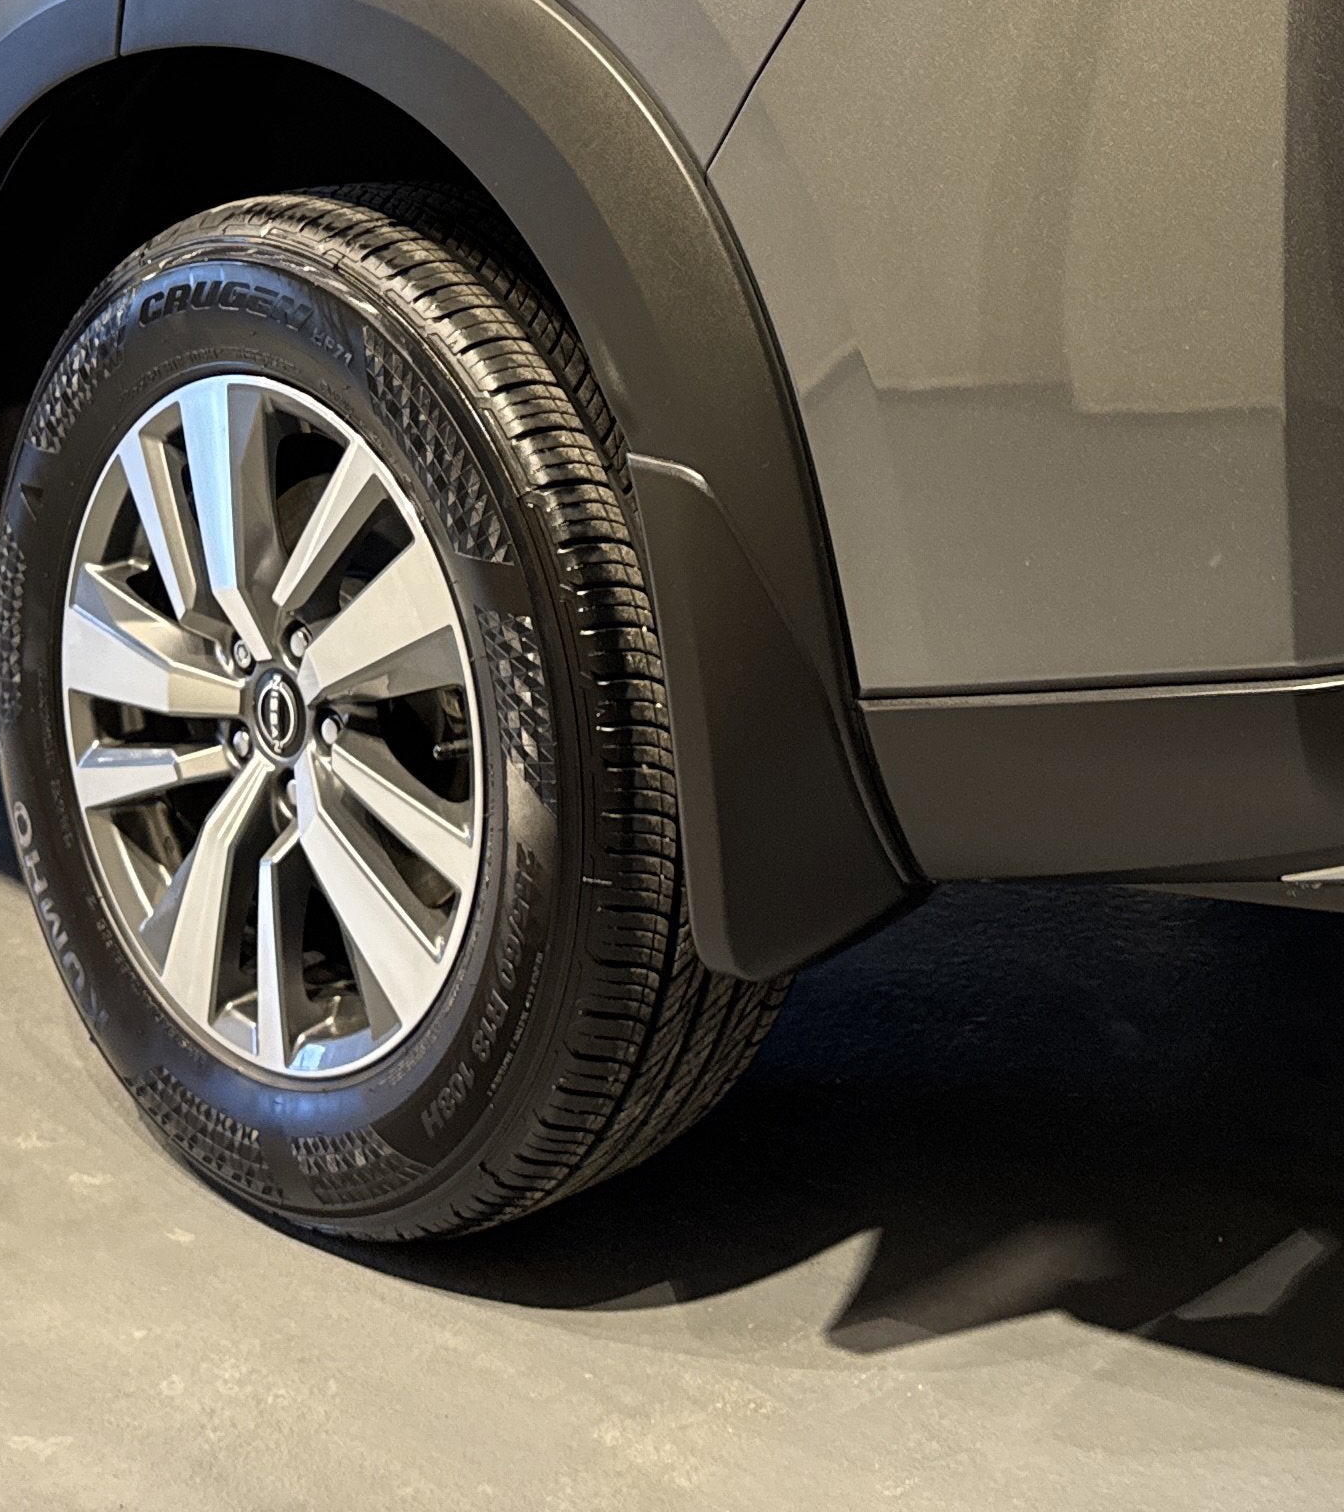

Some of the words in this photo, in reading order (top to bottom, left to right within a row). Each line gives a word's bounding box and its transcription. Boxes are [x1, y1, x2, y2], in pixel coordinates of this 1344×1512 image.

[138, 279, 314, 332] CRUGEN
[12, 800, 110, 1030] KUMHO
[471, 988, 509, 1063] R18
[420, 1061, 476, 1139] 108H
